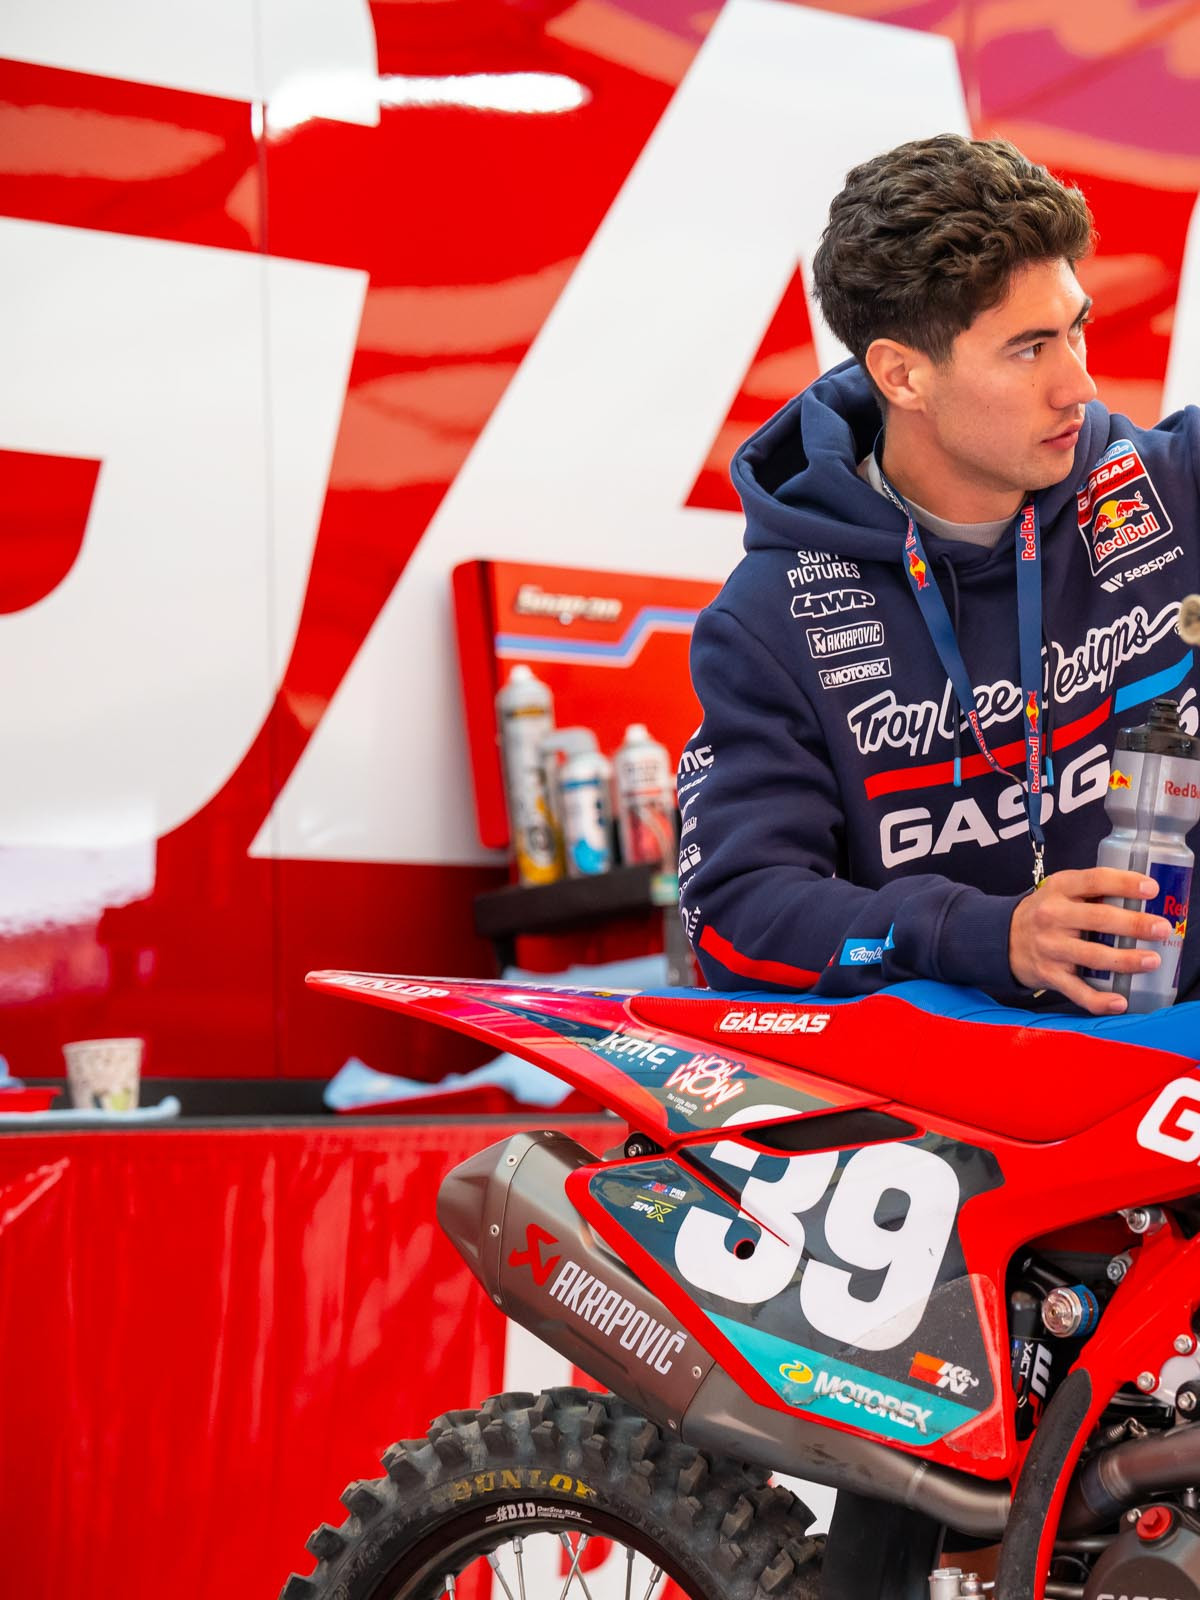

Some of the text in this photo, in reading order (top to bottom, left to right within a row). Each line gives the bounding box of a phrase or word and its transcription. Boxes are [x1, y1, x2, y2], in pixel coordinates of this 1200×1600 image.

[787, 562, 861, 589] PICTURES
[1124, 546, 1185, 582] seaspan
[790, 588, 876, 619] 4WP
[826, 624, 881, 652] AKRAPOVIČ
[830, 661, 887, 686] MOTOREX
[847, 689, 937, 757] Troy
[1029, 736, 1040, 794] Red Bull
[1164, 780, 1190, 798] Red
[719, 1011, 831, 1034] GASGAS
[674, 1103, 961, 1351] 39
[549, 1260, 688, 1375] AKRAPOVIČ
[1019, 1342, 1035, 1379] XACT
[812, 1370, 934, 1437] MOTOREX
